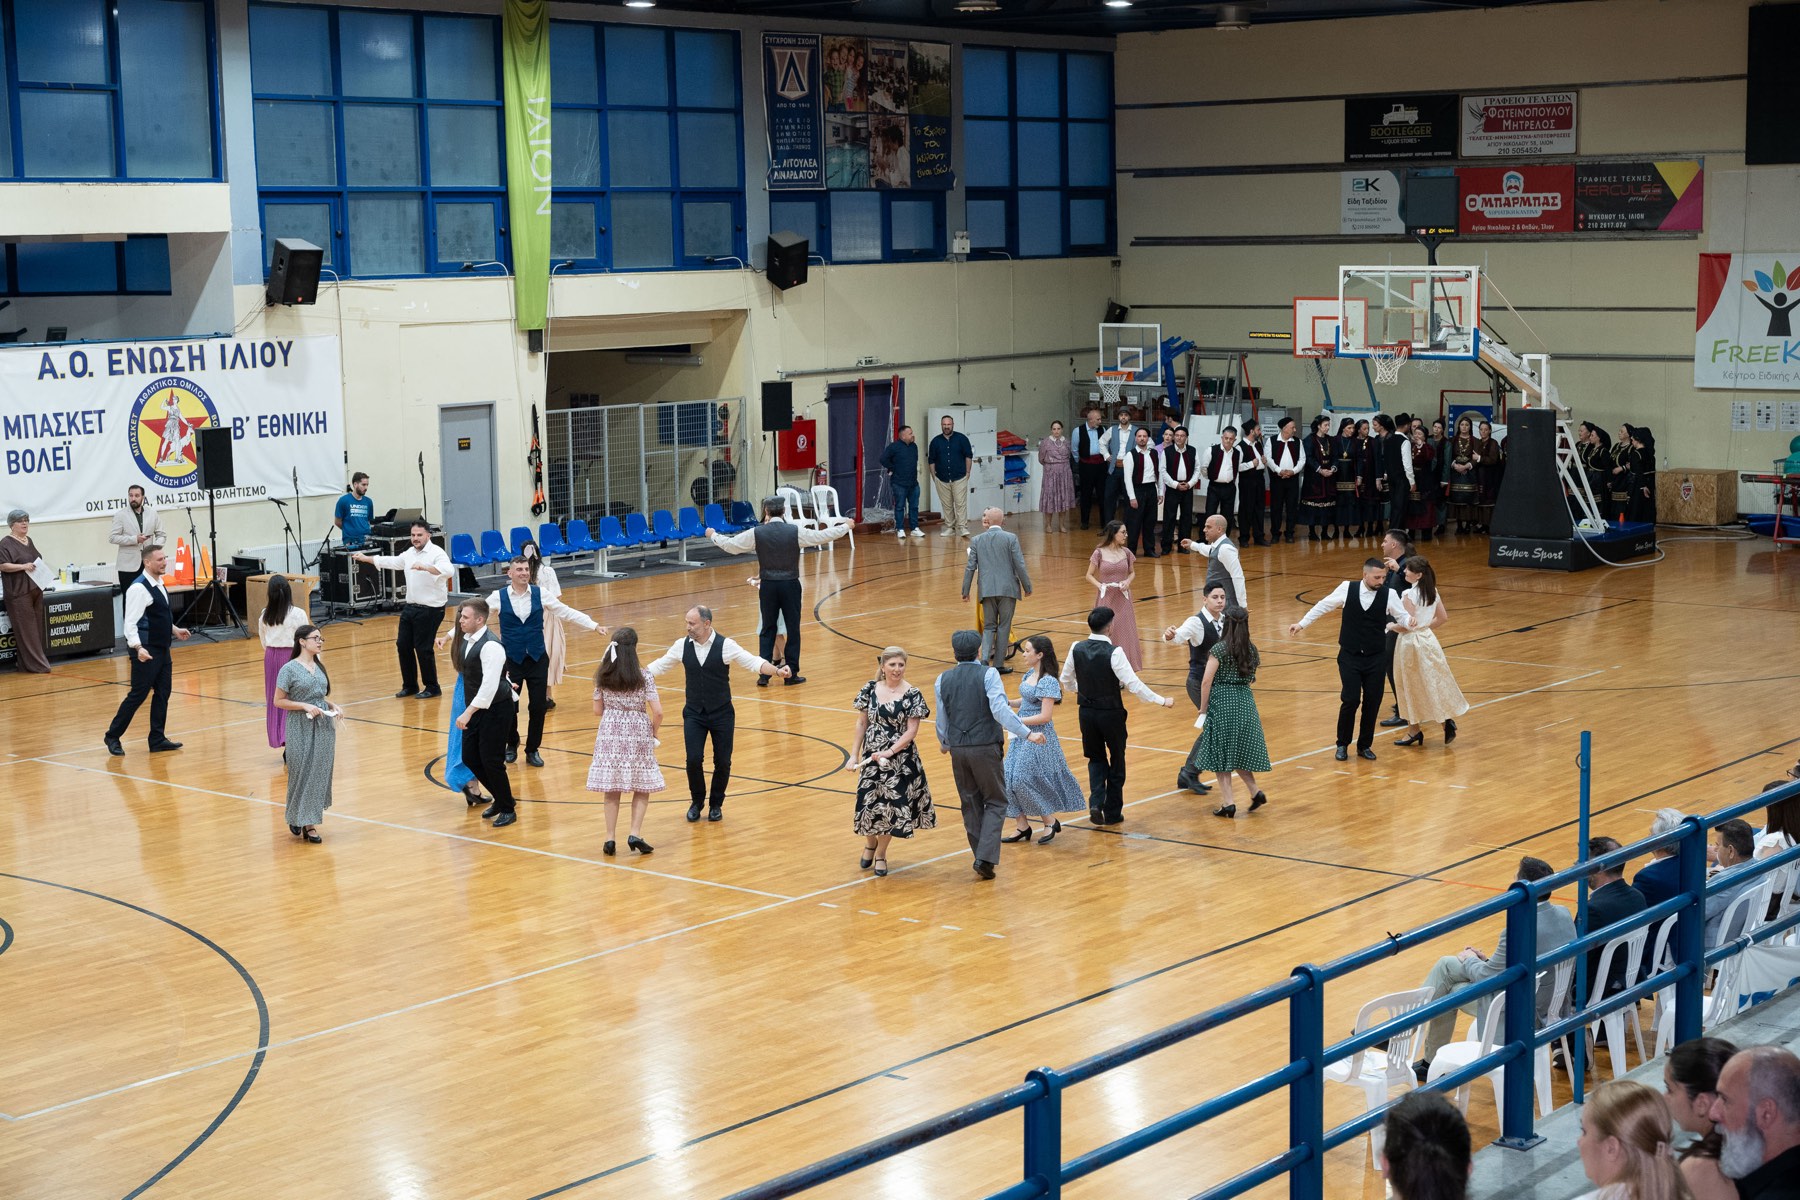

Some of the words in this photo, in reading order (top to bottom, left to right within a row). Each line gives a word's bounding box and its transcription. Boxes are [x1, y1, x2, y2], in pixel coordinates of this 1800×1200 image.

[1484, 98, 1525, 106] ΓΡΑΦΕΙΟ
[1527, 95, 1572, 104] ΤΕΛΕΤΩΝ
[1370, 126, 1432, 137] BOOTLEGGER
[1578, 184, 1664, 196] HERCULES
[1481, 195, 1558, 208] ΜΠΑΡΜΠΑΣ
[108, 344, 206, 376] ΕΝΩΣΗ
[220, 341, 293, 370] ΙΛΙΟΥ
[1723, 369, 1756, 381] Κέντρο
[1759, 371, 1790, 382] Ειδικής
[139, 378, 178, 405] ΑΘΛΗΤΙΚΟΣ
[179, 379, 208, 403] ΟΜΙΛΟΣ
[3, 409, 106, 441] ΜΠΑΣΚΕΤ
[257, 410, 327, 439] ΕΘΝΙΚΗ
[131, 412, 141, 457] ΜΠΑΣΚΕΤ
[6, 440, 72, 475] ΒΟΛΕΪ
[153, 473, 179, 487] ΕΝΩΣΗ
[181, 472, 198, 486] ΙΛΙΟ
[86, 501, 104, 512] ΟΧΙ
[156, 494, 175, 506] ΝΑΙ
[178, 491, 205, 503] ΣΤΟΝ
[1496, 545, 1530, 560] Super
[1531, 547, 1564, 562] Sport
[49, 602, 72, 613] ΠΕΡΙΣΤΕΡΙ
